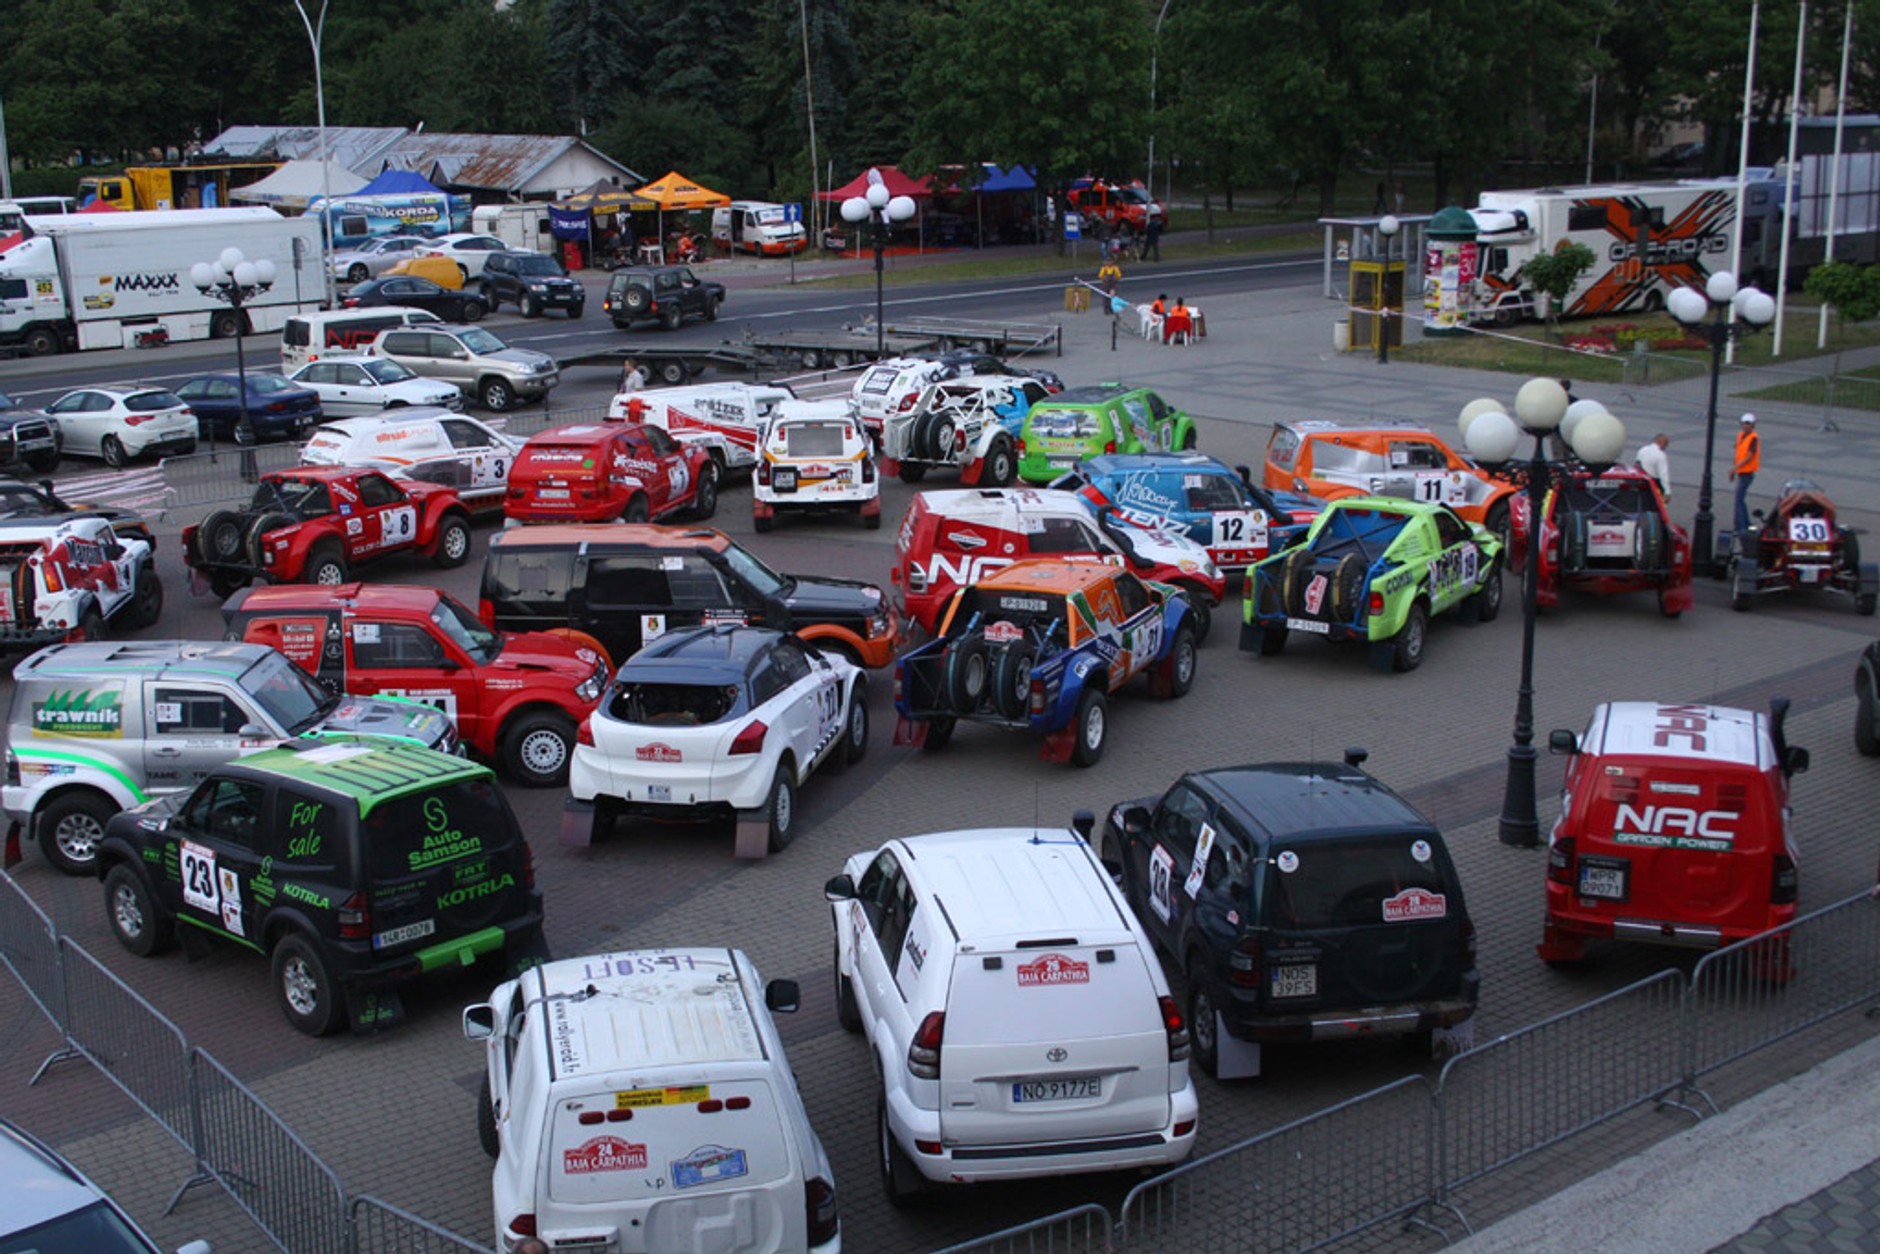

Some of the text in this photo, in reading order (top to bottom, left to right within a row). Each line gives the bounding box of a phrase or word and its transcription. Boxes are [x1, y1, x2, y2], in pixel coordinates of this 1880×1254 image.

[385, 206, 438, 218] KORDA
[115, 272, 179, 292] MAXXX
[494, 459, 505, 479] 3
[1423, 479, 1441, 501] 11
[400, 513, 409, 535] 8
[1119, 505, 1193, 536] TENZI
[1220, 518, 1244, 542] 12
[1794, 523, 1827, 541] 30
[36, 707, 119, 724] trawnik
[1653, 702, 1708, 752] NAC
[290, 802, 325, 828] For
[1614, 803, 1740, 839] NAC
[286, 828, 321, 859] sale
[423, 830, 463, 849] Auto
[1617, 832, 1729, 850] GARDEN POWER
[407, 837, 481, 865] Samson
[185, 855, 214, 899] 23
[283, 882, 331, 910] KOTRLA
[436, 873, 516, 910] KOTRLA
[1280, 966, 1310, 980] NOS
[1276, 980, 1313, 995] 39FS
[1022, 1078, 1098, 1099] NO 9177E
[599, 1143, 613, 1157] 24
[566, 1153, 645, 1170] BAJA CARPATHIA
